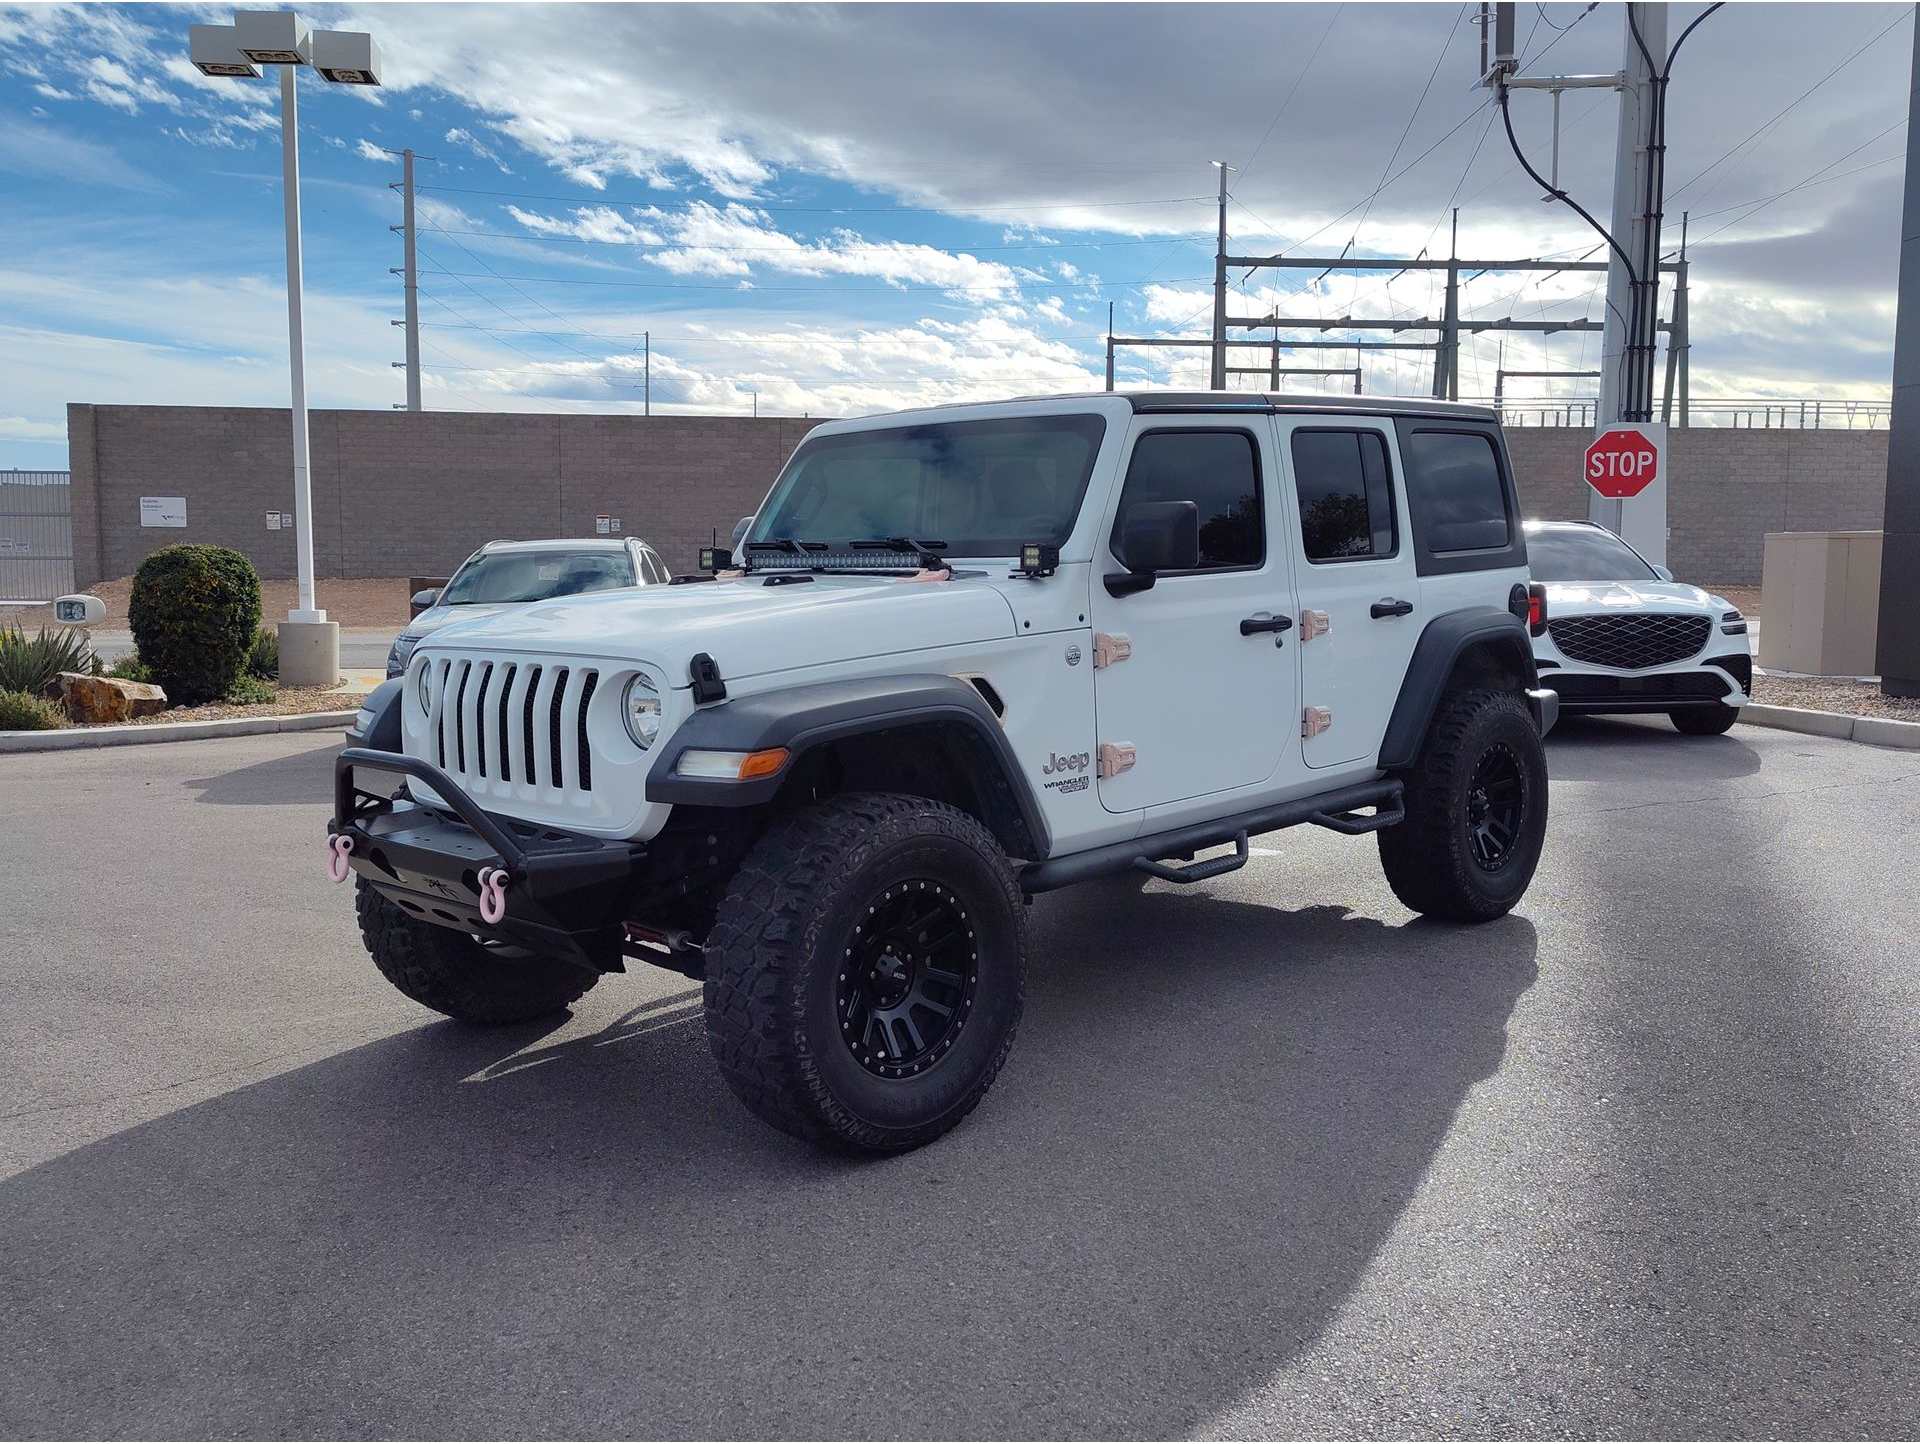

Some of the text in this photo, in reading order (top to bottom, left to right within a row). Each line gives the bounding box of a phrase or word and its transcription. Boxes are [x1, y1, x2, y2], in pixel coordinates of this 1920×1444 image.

[1589, 451, 1653, 478] STOP
[1042, 752, 1090, 775] Jeep
[1043, 775, 1089, 789] WRANGLER
